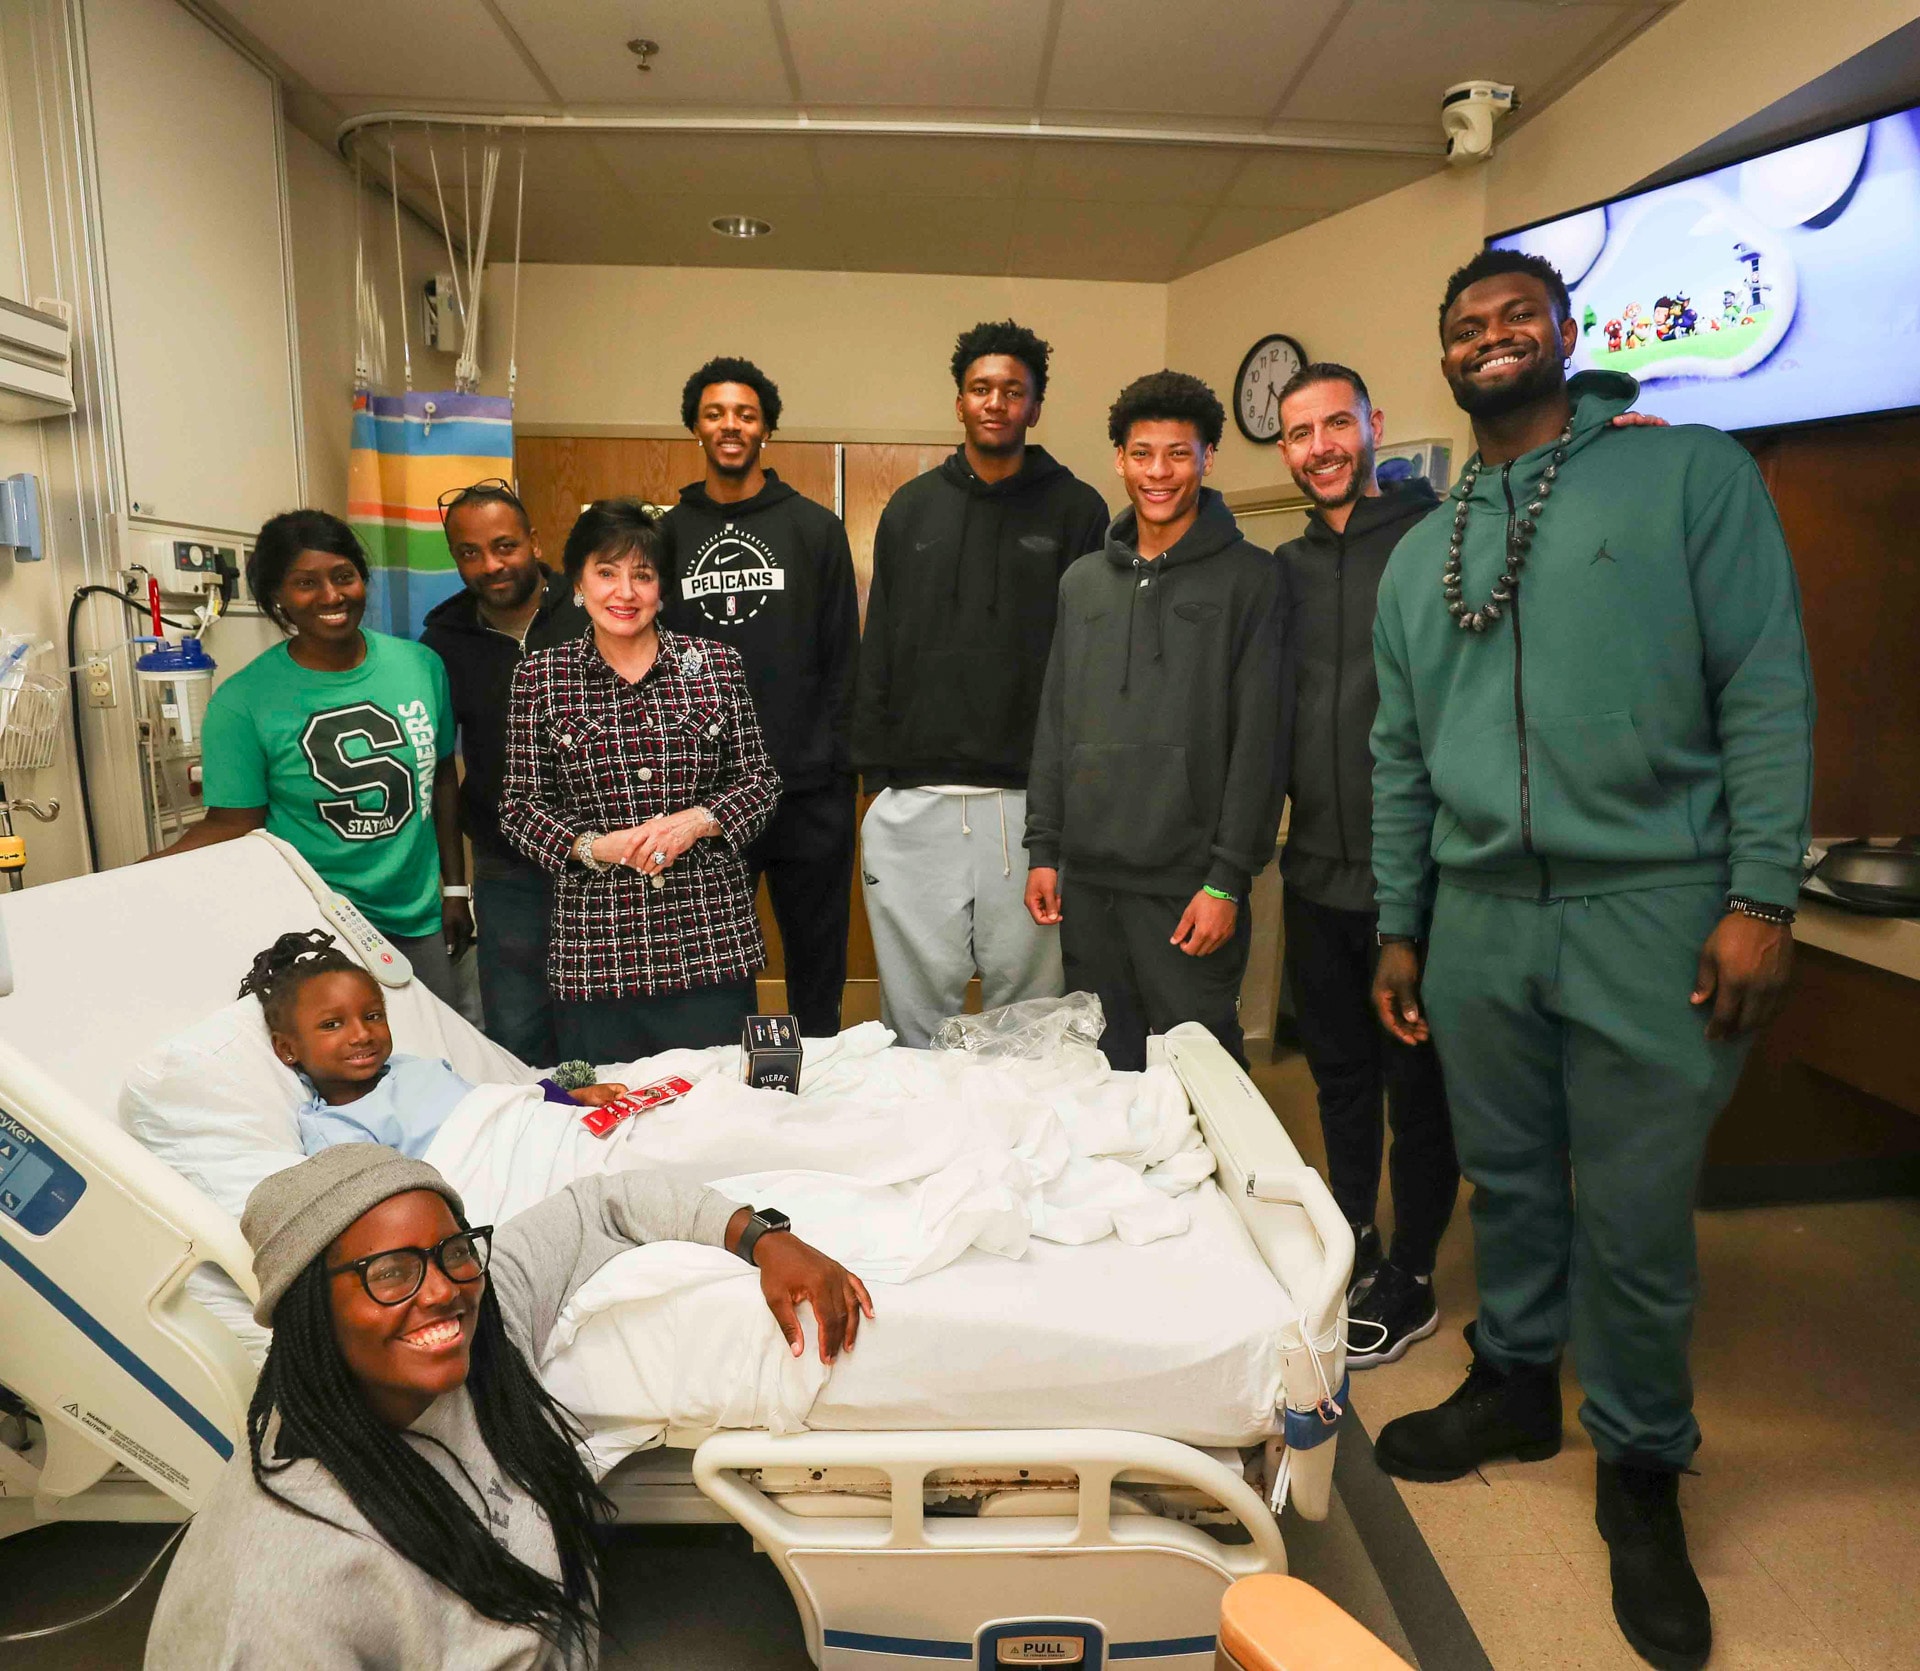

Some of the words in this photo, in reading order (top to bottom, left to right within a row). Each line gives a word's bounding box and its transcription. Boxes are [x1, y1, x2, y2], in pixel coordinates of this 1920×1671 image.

[1269, 349, 1280, 362] 12
[1260, 357, 1267, 369] 11
[1291, 360, 1299, 374] 2
[1251, 370, 1260, 383] 10
[1246, 389, 1253, 401] 9
[1249, 405, 1256, 418] 8
[1257, 415, 1263, 428] 7
[1267, 417, 1274, 430] 6
[691, 572, 773, 594] PELICANS
[298, 700, 417, 842] S
[760, 1073, 789, 1084] PIERRE
[1023, 1643, 1065, 1653] PULL
